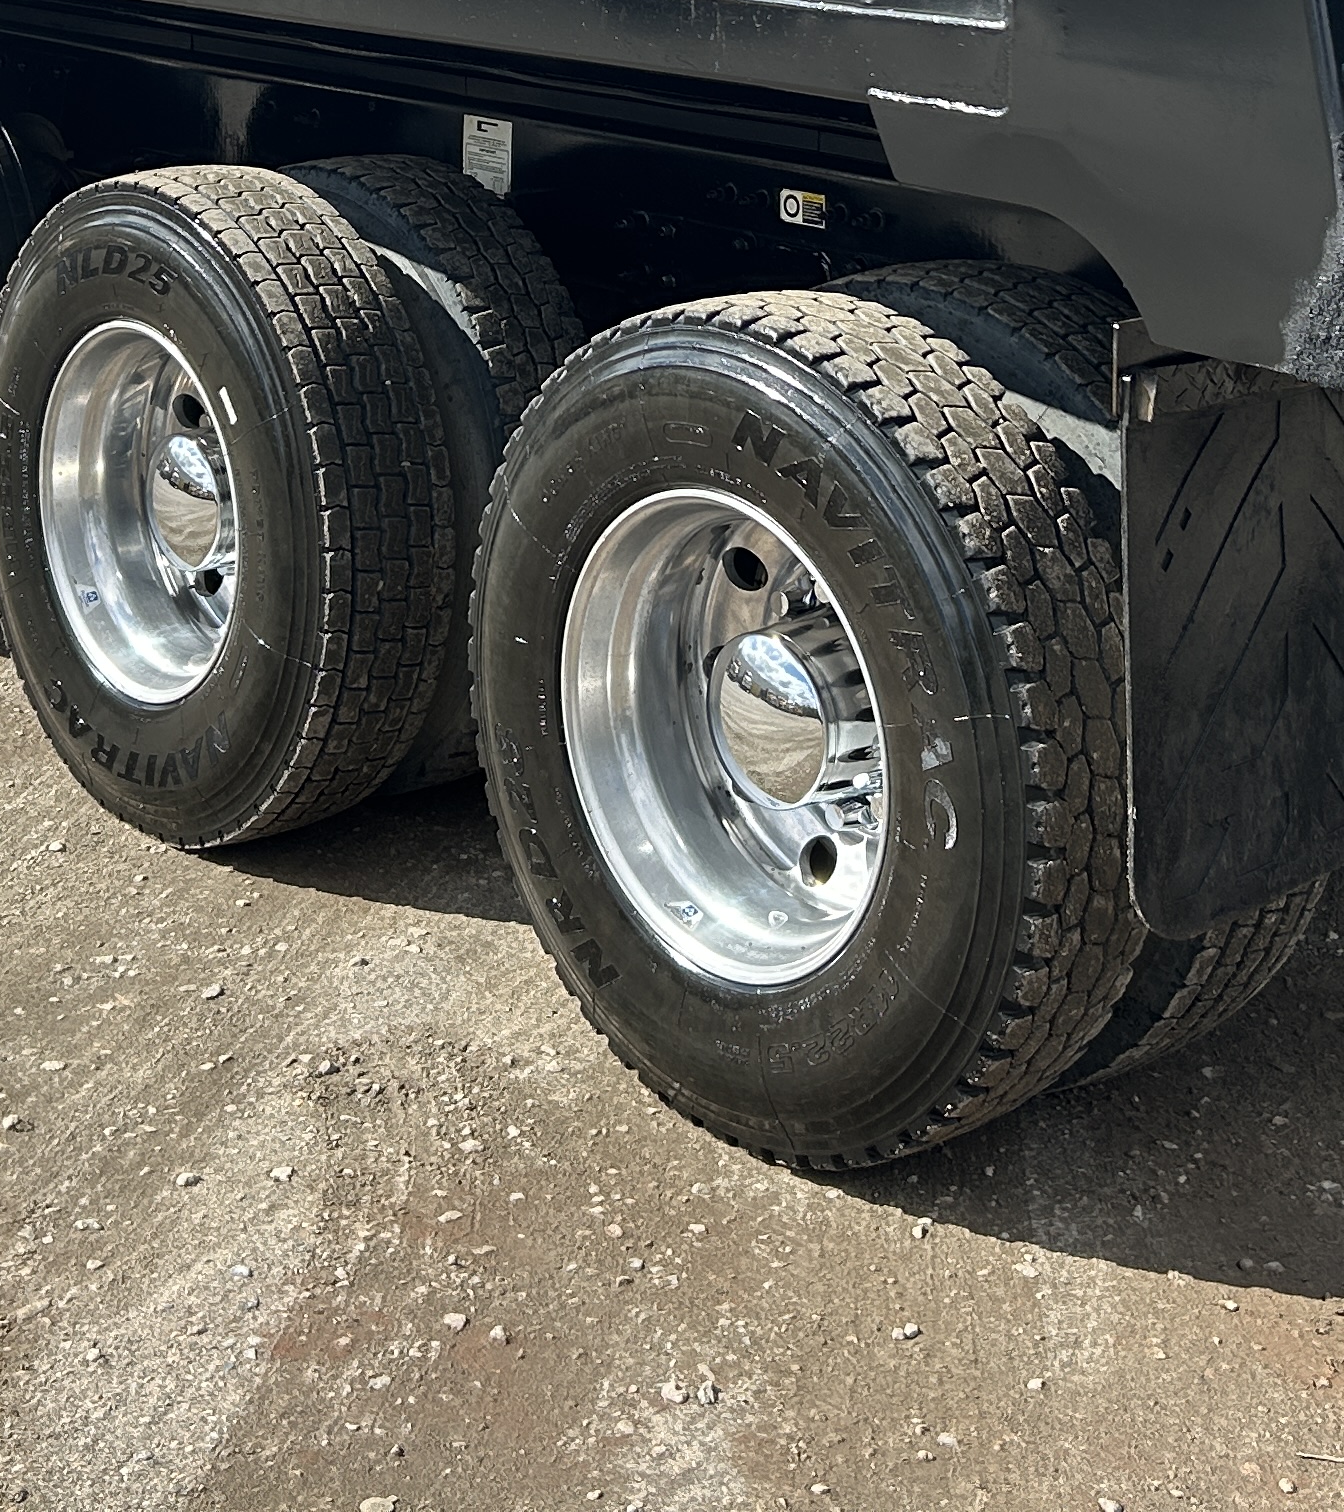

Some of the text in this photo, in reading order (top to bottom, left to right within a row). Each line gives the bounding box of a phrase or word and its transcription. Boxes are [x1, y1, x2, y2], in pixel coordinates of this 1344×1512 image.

[56, 242, 180, 296] NLD25
[731, 408, 957, 851] NAVITRAC
[44, 678, 231, 788] NAVITRAC
